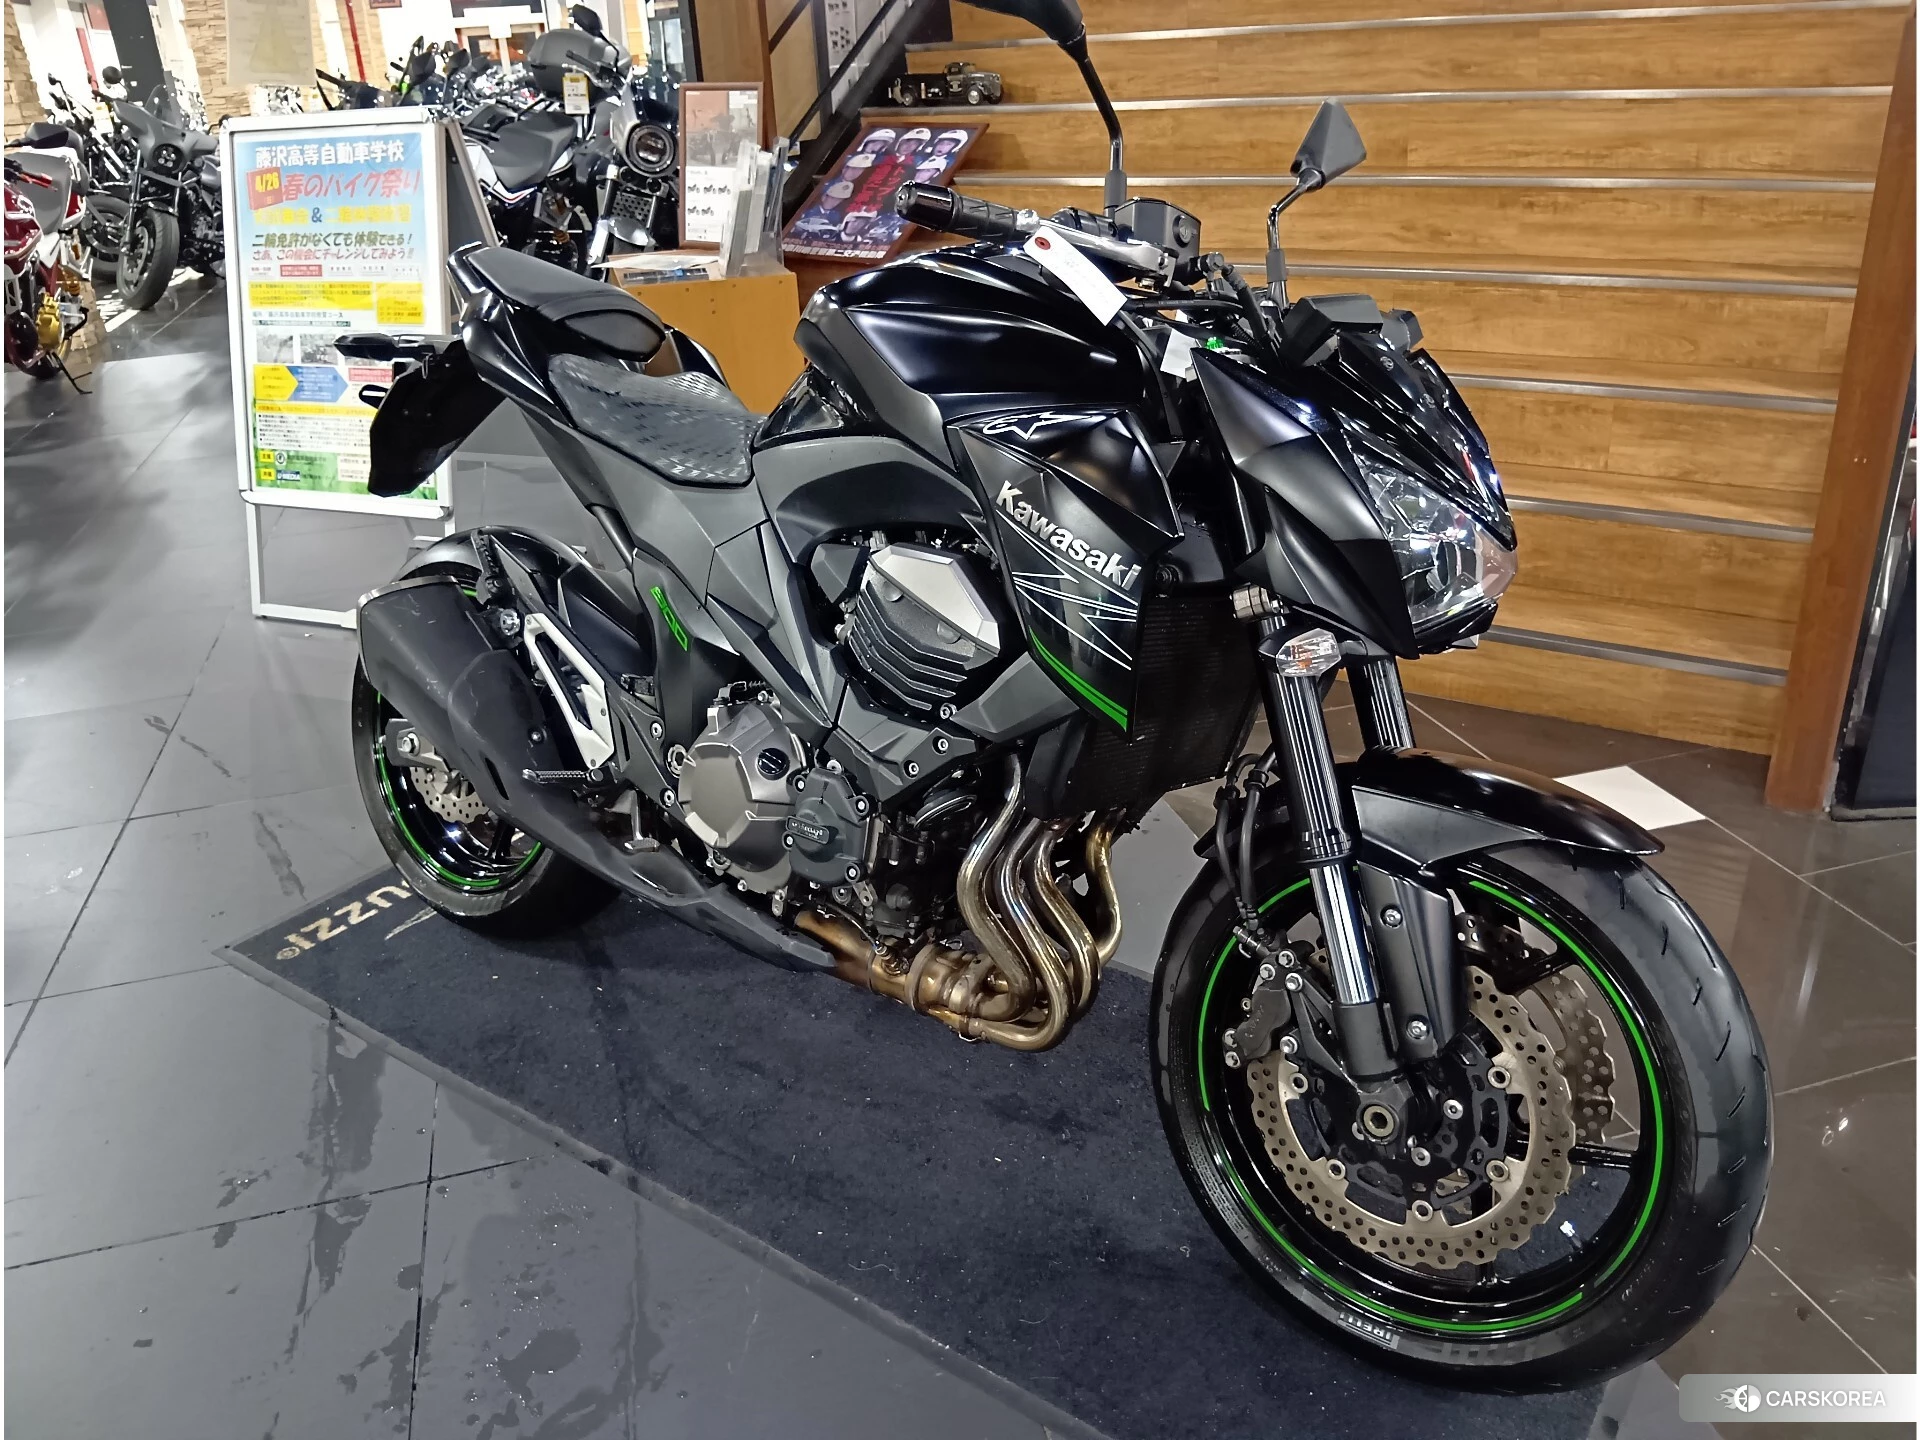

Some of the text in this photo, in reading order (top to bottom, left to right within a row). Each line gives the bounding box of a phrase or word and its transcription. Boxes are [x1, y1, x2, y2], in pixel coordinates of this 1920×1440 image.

[255, 139, 405, 168] 藤沢高等自動車学校
[255, 172, 280, 193] 4/26
[283, 169, 421, 201] 春のバイク祭り
[996, 480, 1142, 591] Kawasaki
[284, 880, 412, 950] UZZI
